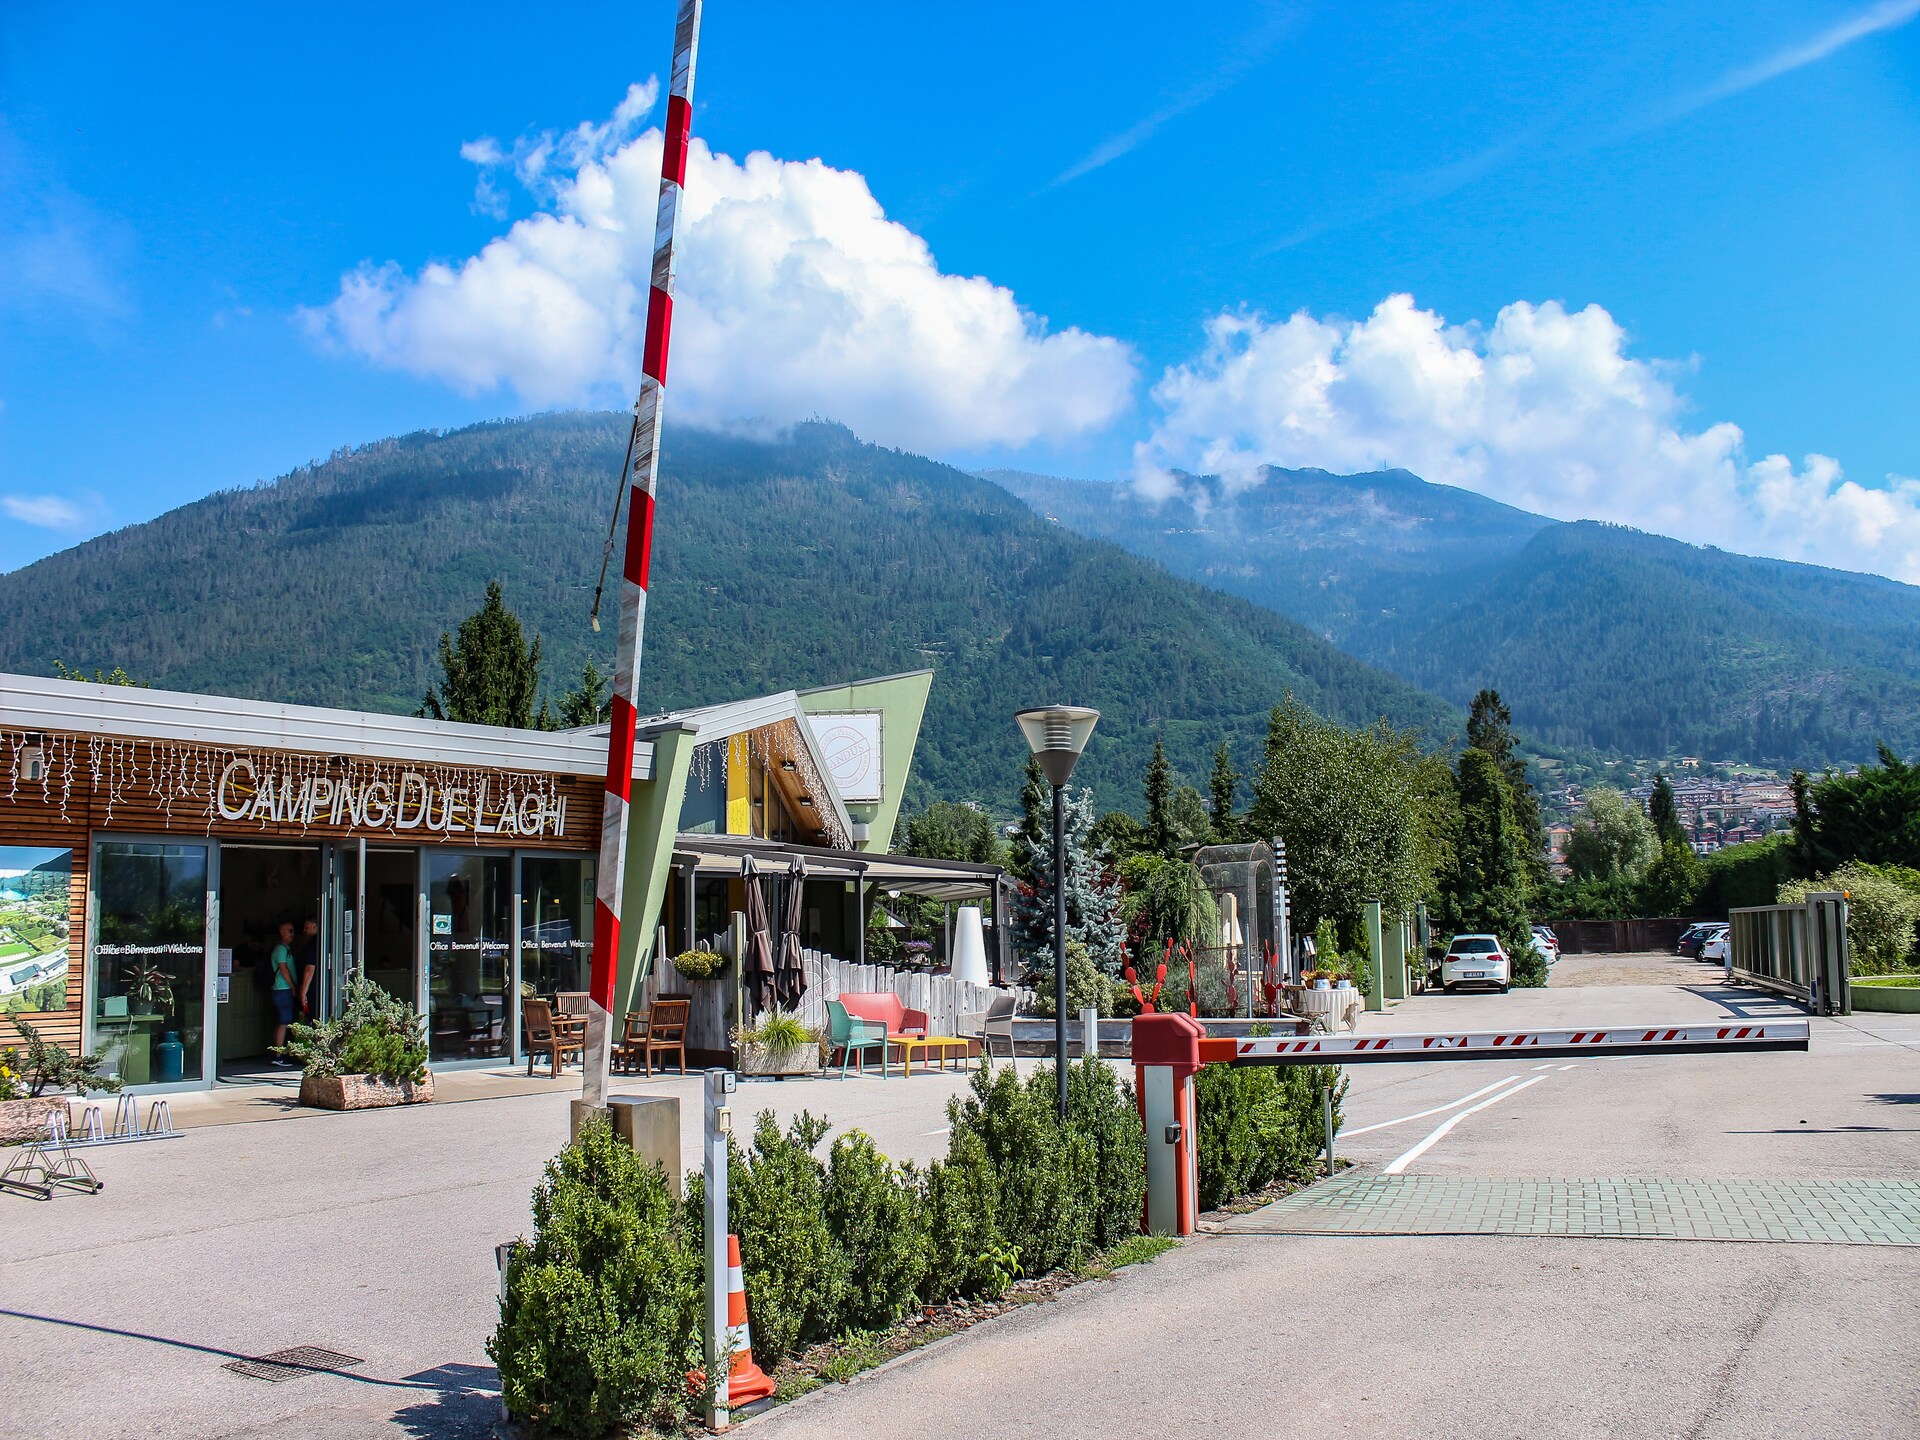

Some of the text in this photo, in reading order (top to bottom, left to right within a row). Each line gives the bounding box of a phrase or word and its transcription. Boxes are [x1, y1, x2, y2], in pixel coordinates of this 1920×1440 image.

[828, 744, 865, 768] ANDUS
[217, 758, 568, 837] CAMPING DUE LAGHI
[429, 941, 510, 951] Office Benvenuti Welcome
[521, 940, 539, 949] Office
[541, 940, 567, 949] Benvenuti
